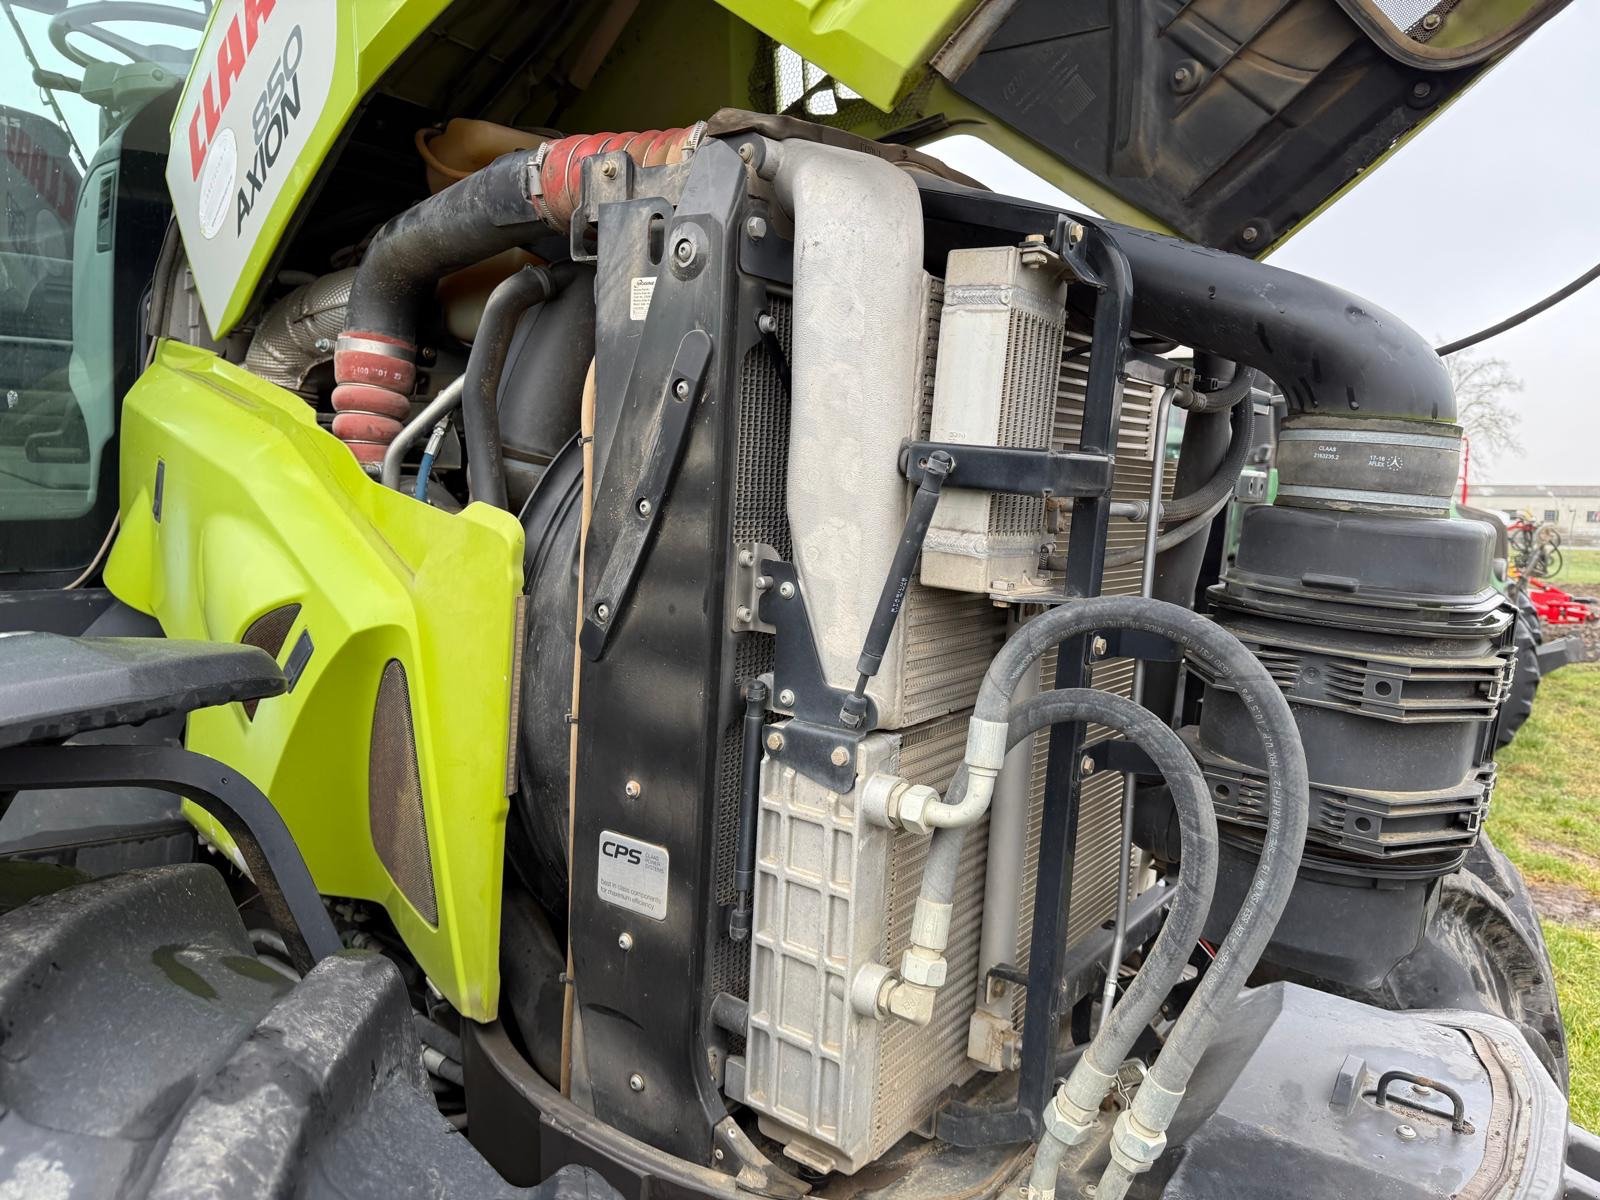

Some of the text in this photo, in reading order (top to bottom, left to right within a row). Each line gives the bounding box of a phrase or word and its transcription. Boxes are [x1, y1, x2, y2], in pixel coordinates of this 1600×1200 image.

[252, 24, 303, 146] 850
[237, 71, 301, 239] AXION
[602, 841, 643, 865] CPS
